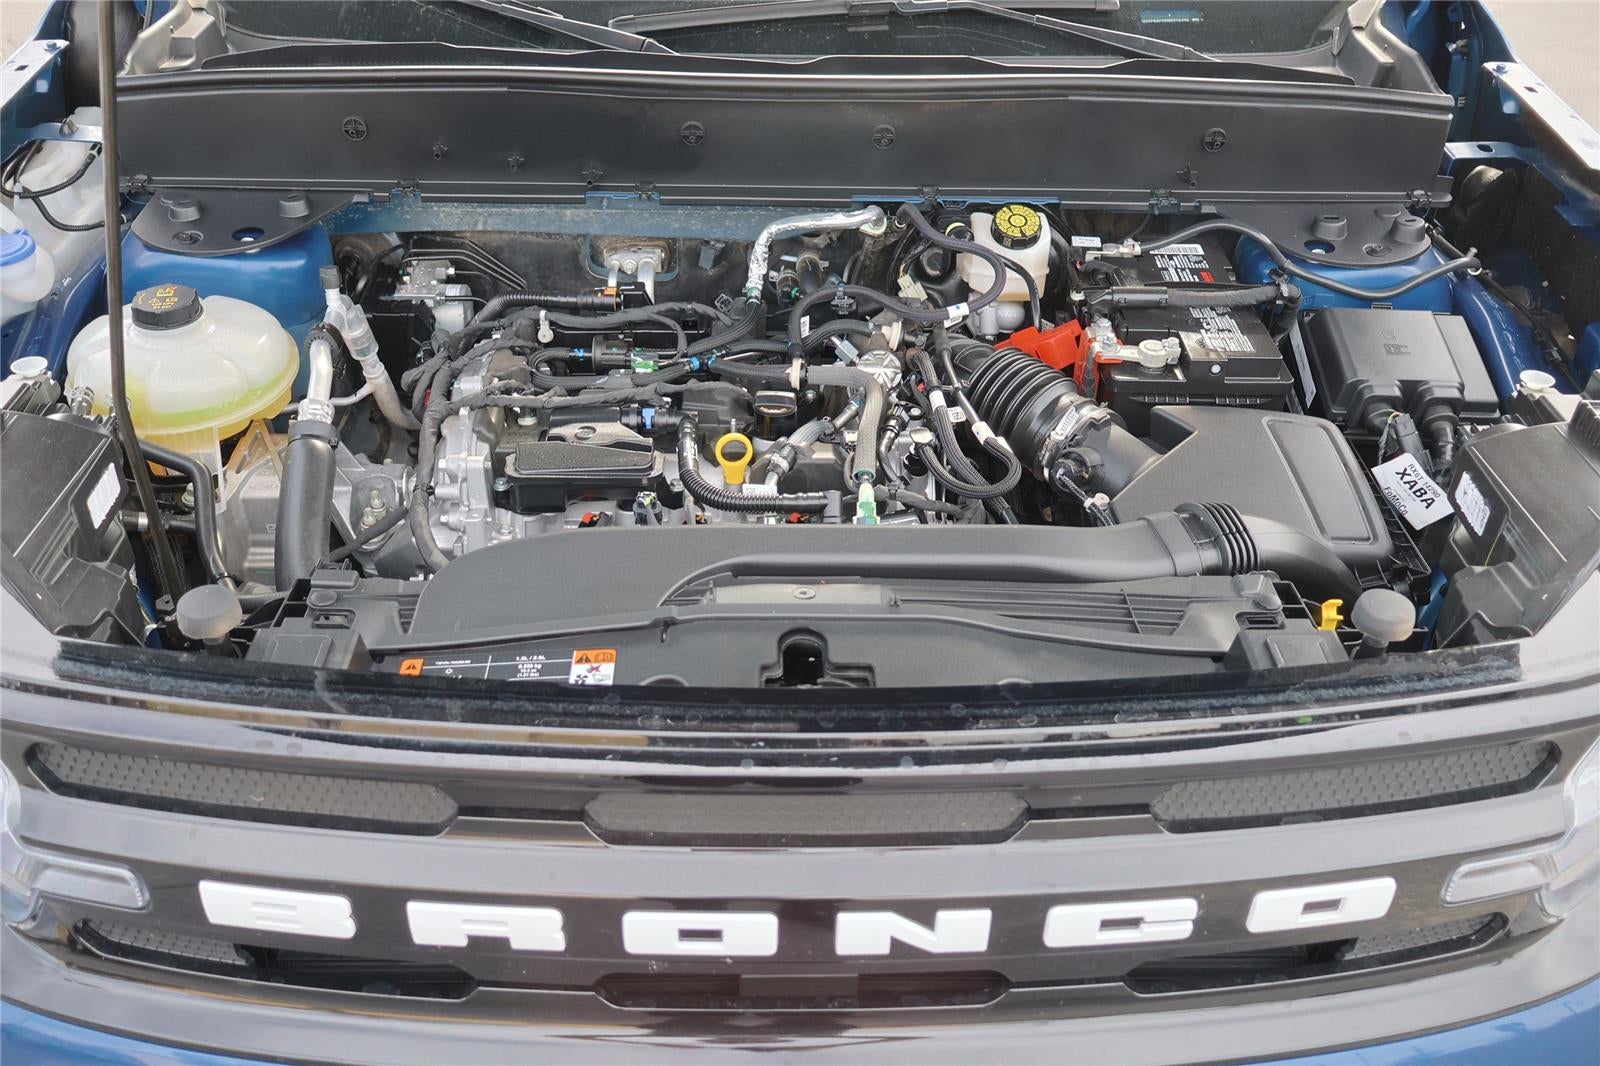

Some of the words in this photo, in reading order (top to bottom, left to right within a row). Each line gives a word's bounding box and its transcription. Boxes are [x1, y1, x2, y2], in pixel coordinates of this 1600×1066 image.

[1383, 486, 1408, 516] FoMoCo
[1394, 467, 1436, 510] XABA
[1423, 481, 1441, 498] 14290
[198, 876, 1397, 956] BRONCO
